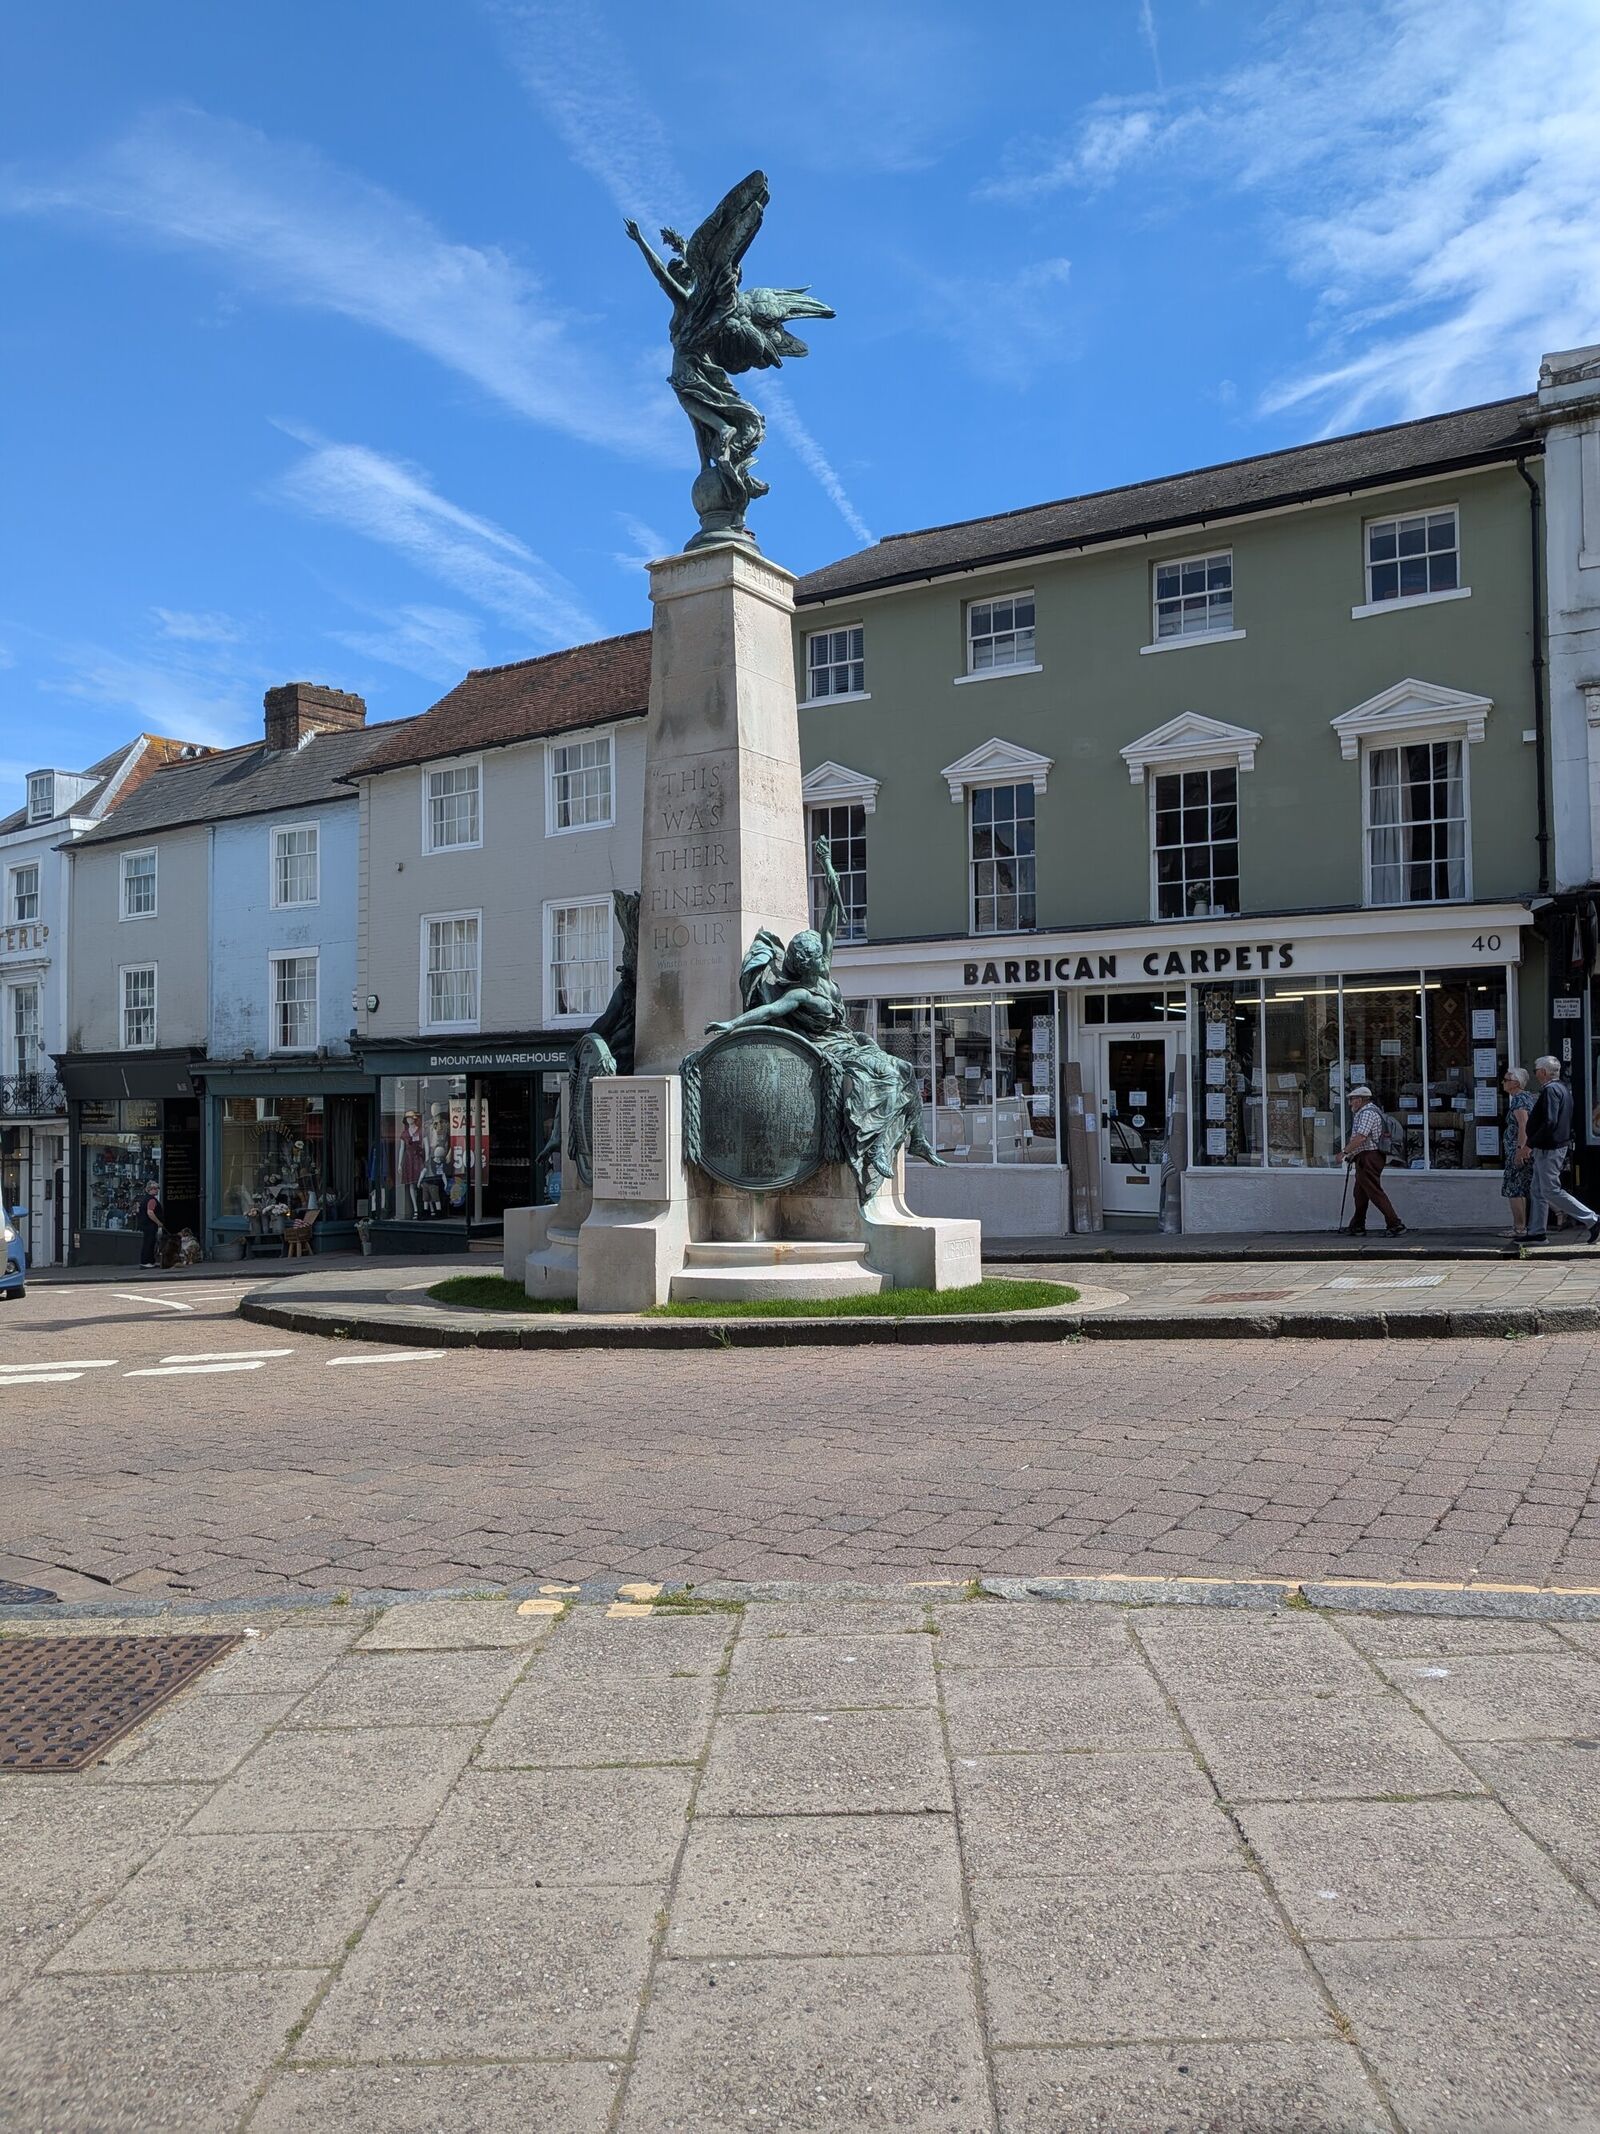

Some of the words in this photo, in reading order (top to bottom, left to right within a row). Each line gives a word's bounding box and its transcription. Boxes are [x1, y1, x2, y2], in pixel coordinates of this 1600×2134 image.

[661, 804, 721, 832] WAS
[655, 843, 729, 872] THEIR
[650, 882, 734, 911] FINEST
[1471, 934, 1501, 952] 40
[963, 955, 1117, 985] BARBICAN
[1143, 943, 1294, 976] CARPETS
[1130, 1032, 1141, 1040] 40
[438, 1054, 493, 1066] MOUNTAIN
[495, 1052, 567, 1064] WAREHOUSE
